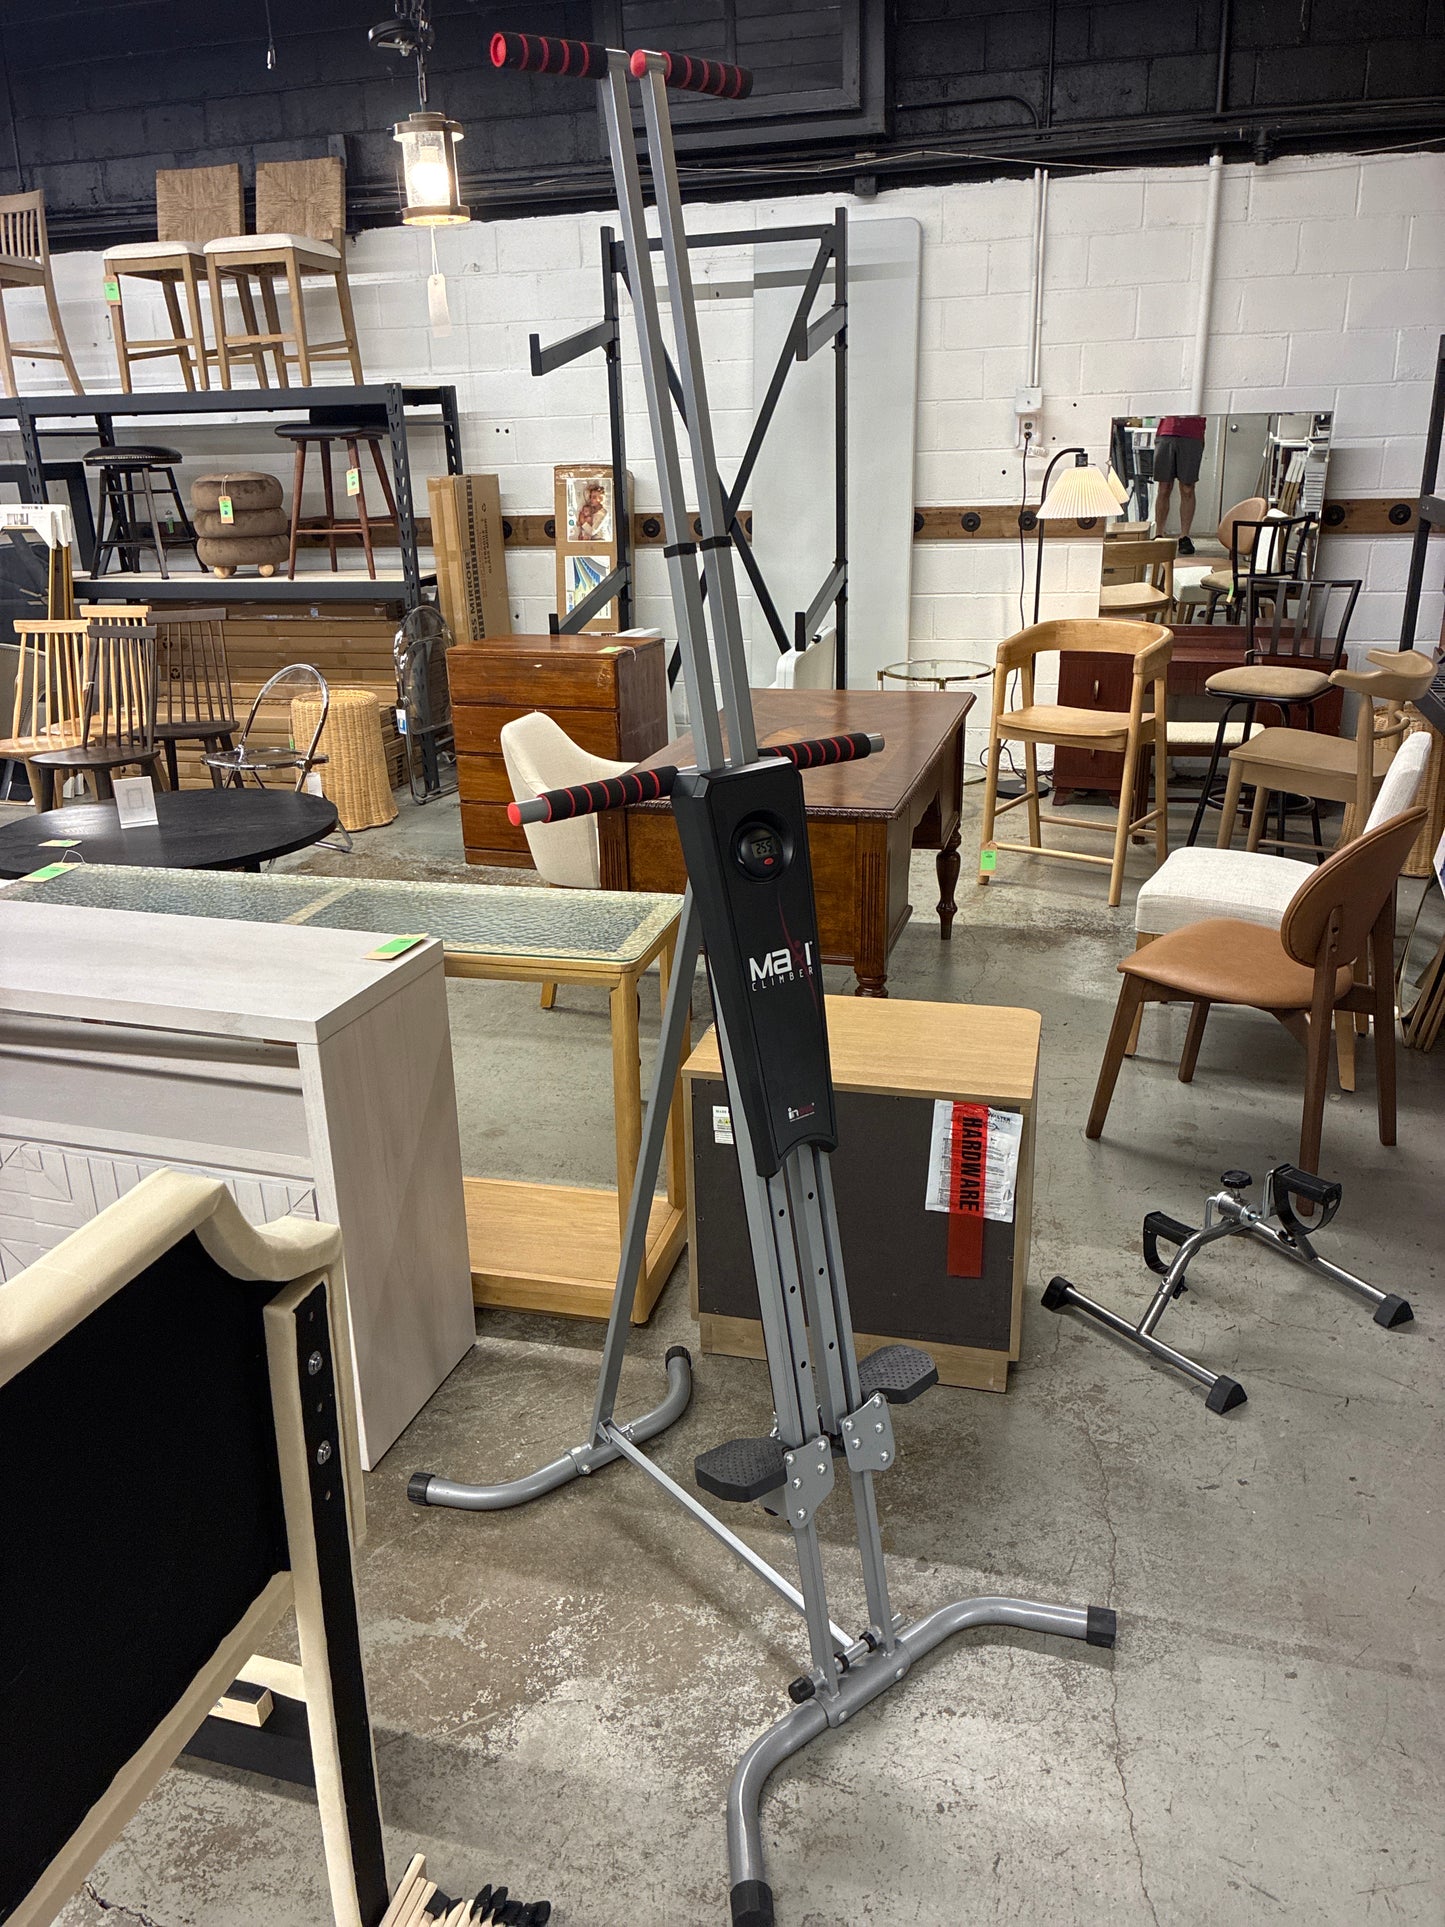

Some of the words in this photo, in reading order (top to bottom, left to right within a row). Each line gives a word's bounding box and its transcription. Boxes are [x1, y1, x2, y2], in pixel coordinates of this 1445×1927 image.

[465, 561, 477, 615] MIRROR
[755, 840, 772, 855] 255
[751, 966, 814, 992] CLIMBER
[959, 1116, 983, 1212] HARDWARE
